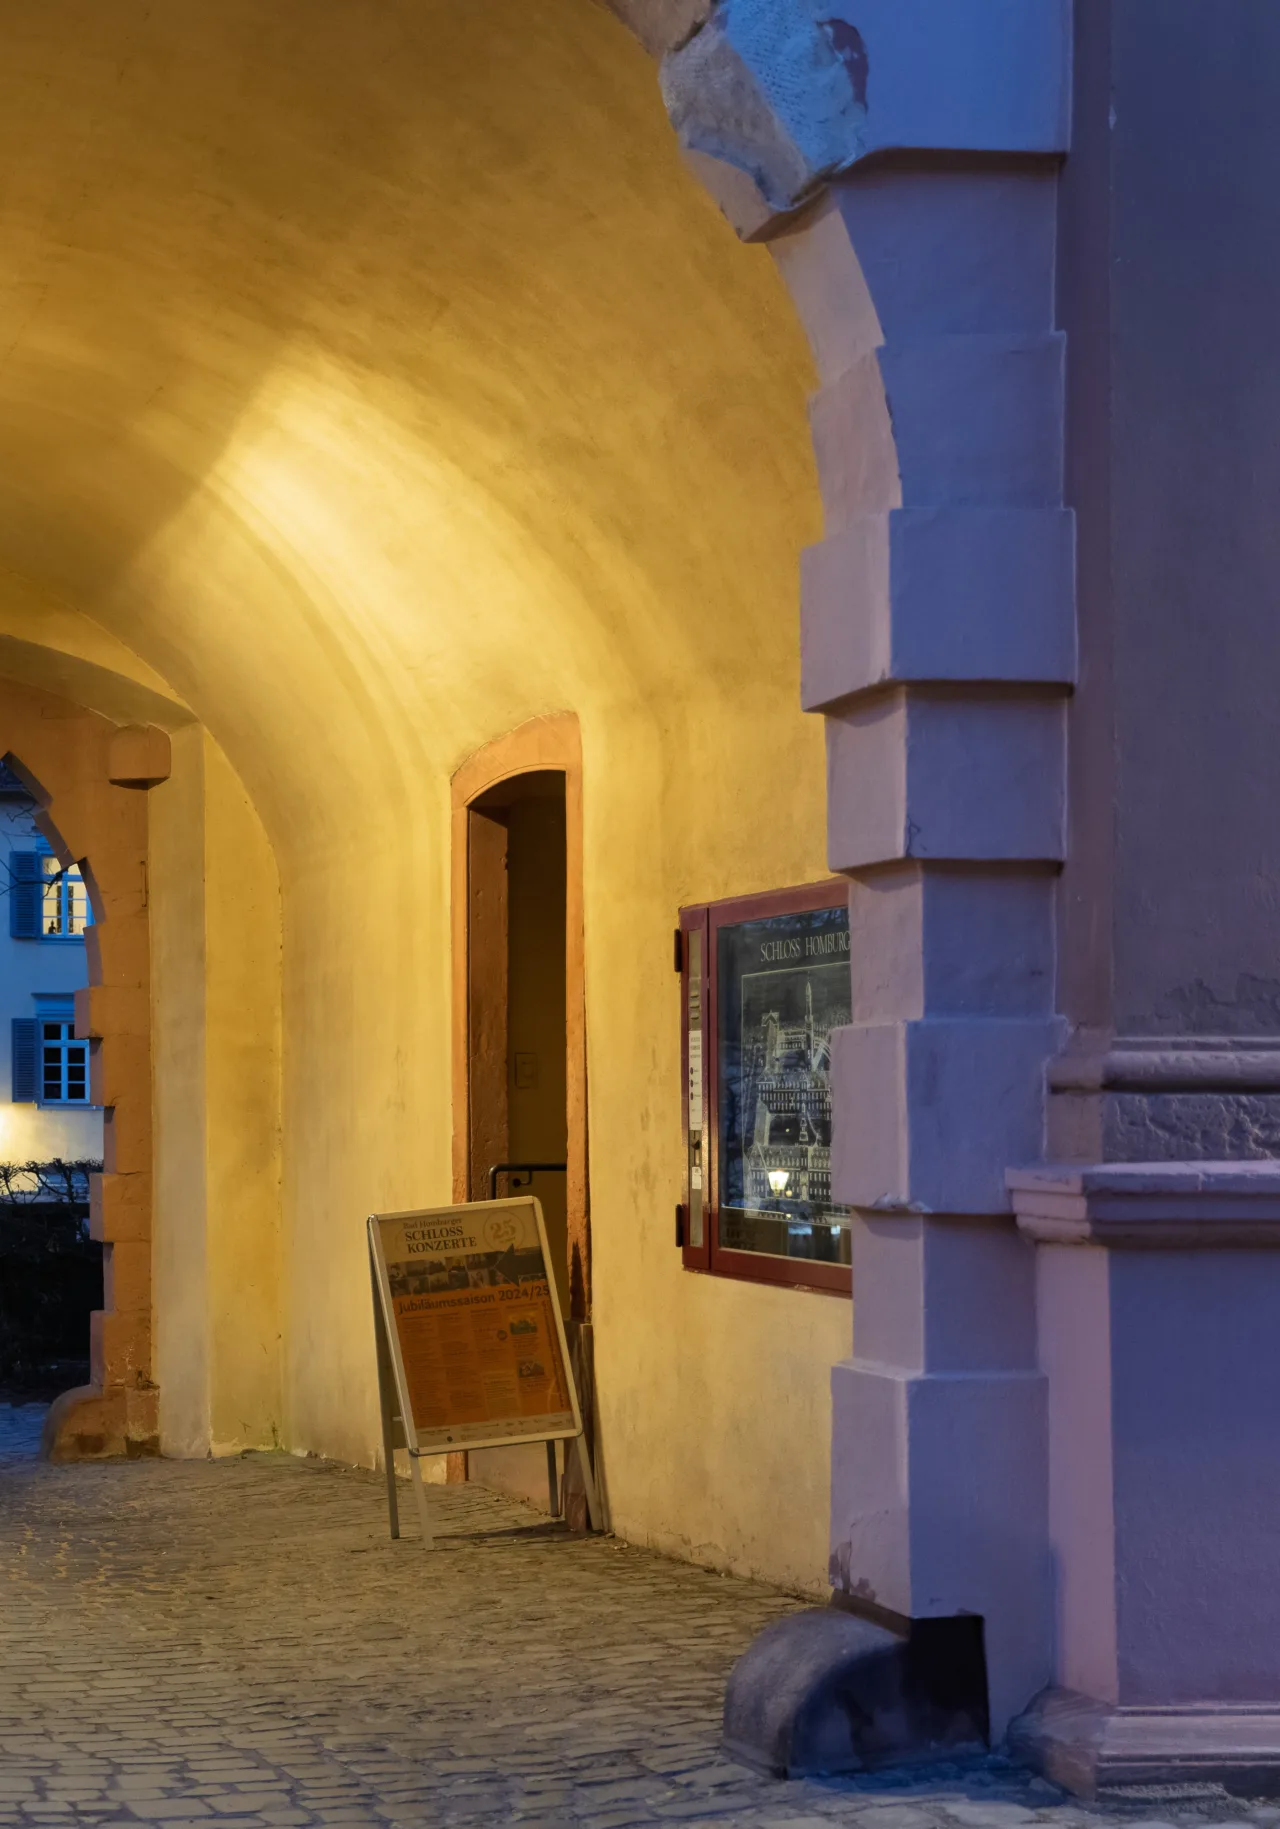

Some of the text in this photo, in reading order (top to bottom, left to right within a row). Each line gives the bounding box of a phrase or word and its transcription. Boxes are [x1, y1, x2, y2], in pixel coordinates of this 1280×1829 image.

[760, 930, 850, 962] SCHLOSS HOMBURG
[403, 1217, 462, 1230] Bad Homburger
[405, 1225, 464, 1242] SCHLOSS
[490, 1218, 517, 1240] 25
[407, 1236, 477, 1254] KONZERTE
[399, 1292, 495, 1314] Jubiläumssaison
[498, 1284, 550, 1302] 2024/25
